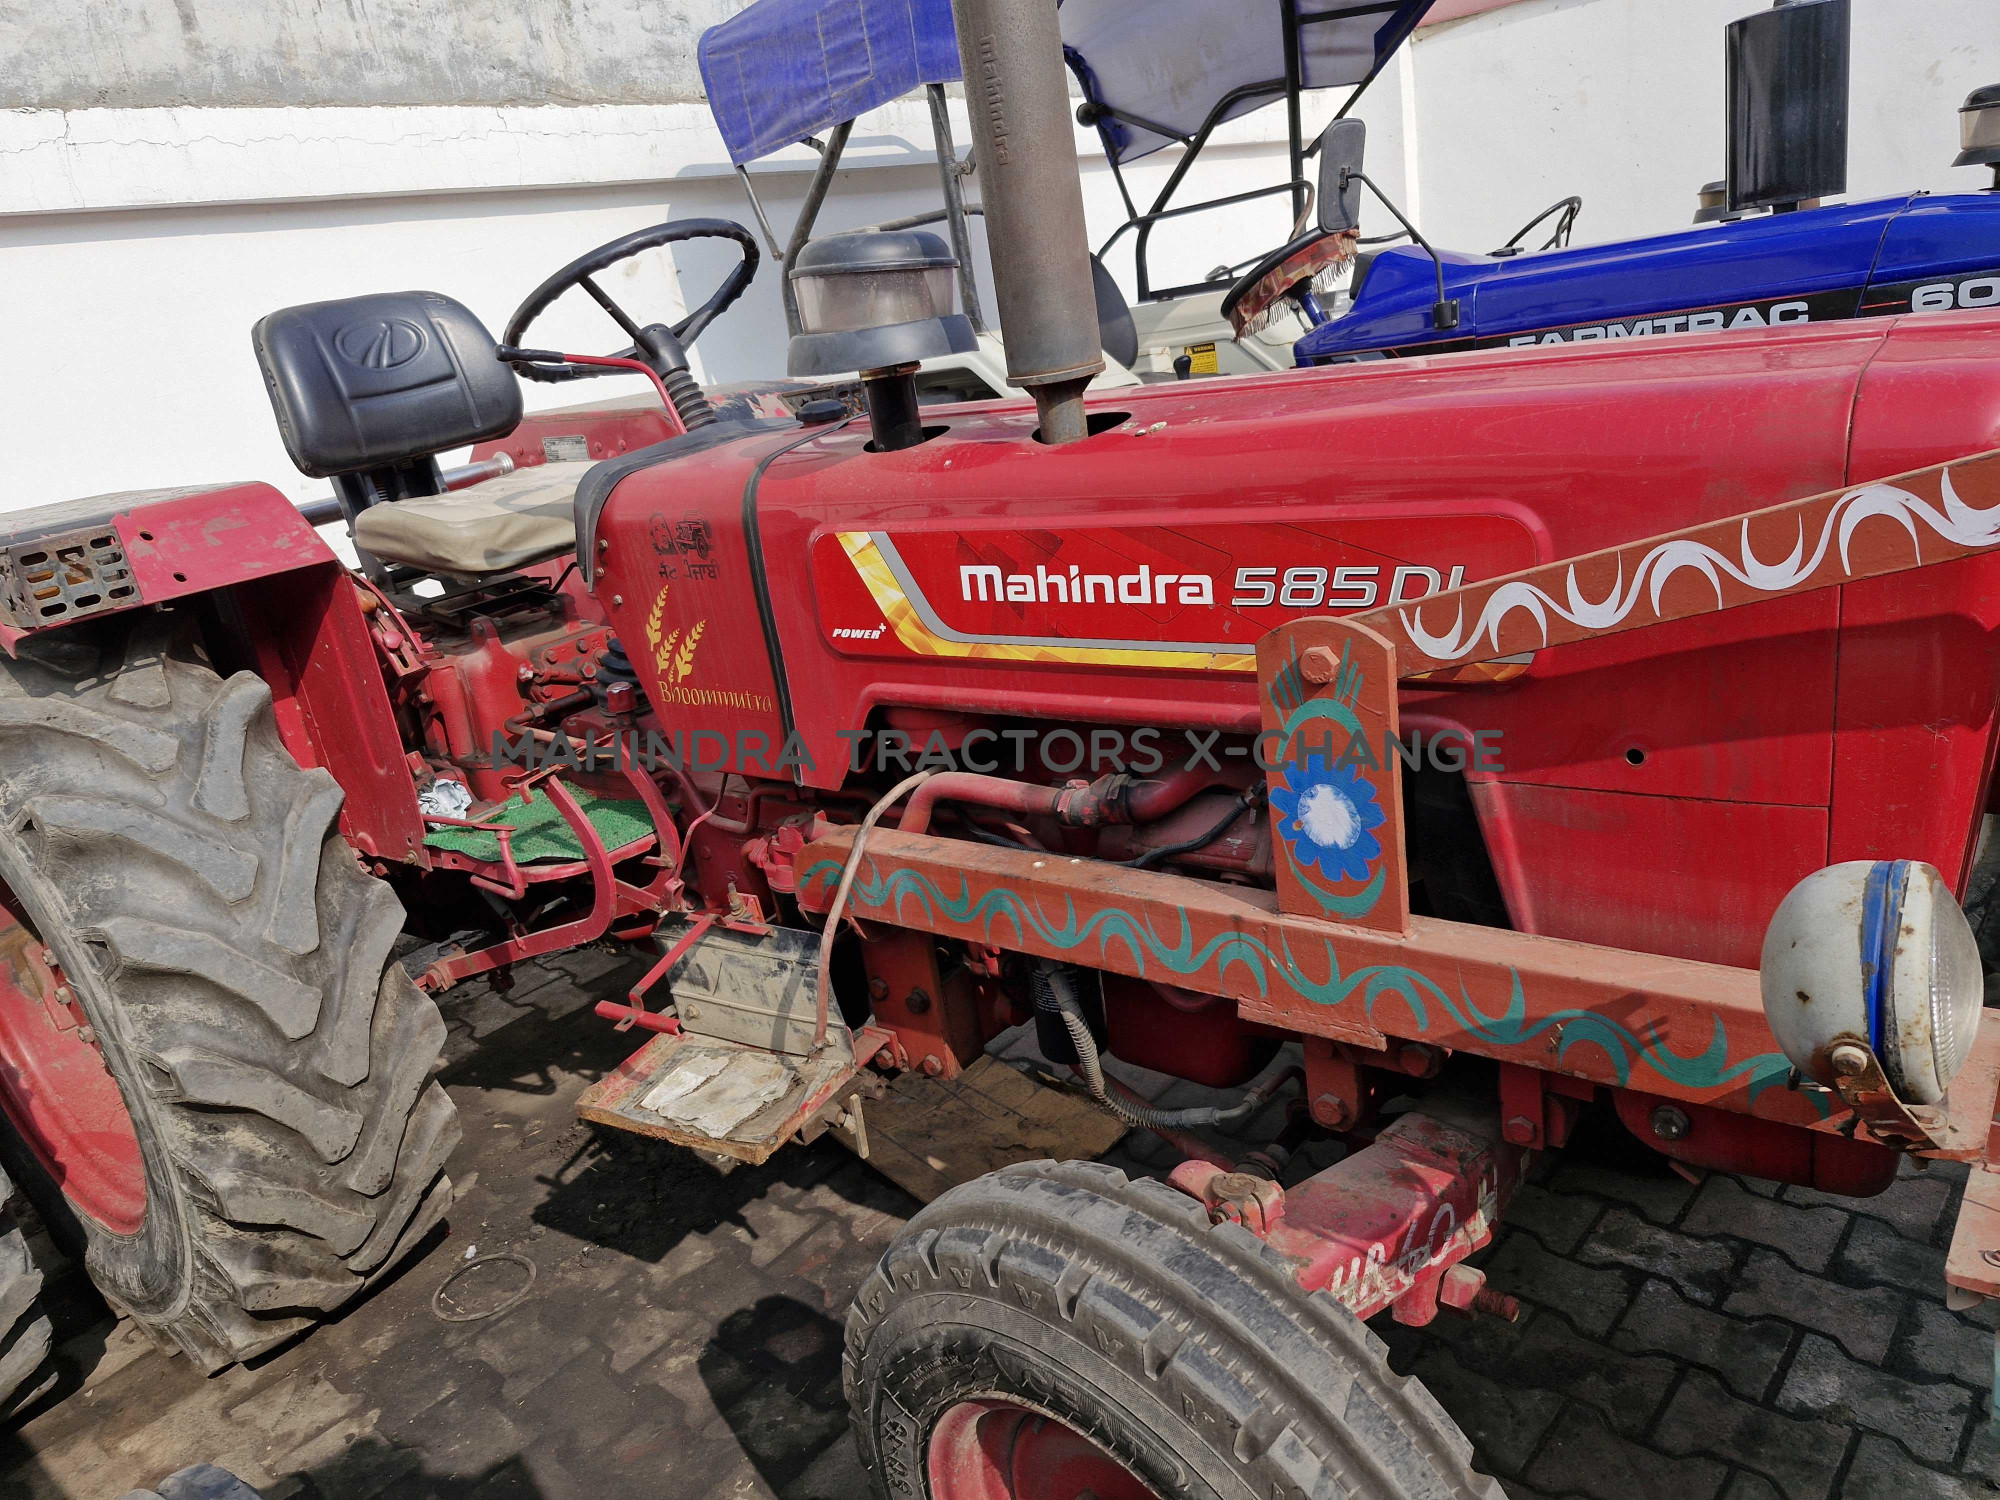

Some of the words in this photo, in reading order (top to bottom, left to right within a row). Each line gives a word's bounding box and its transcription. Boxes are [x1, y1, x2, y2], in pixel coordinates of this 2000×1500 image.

[1911, 277, 2000, 313] 60
[959, 564, 1214, 605] Mahindra
[1231, 566, 1379, 607] 585
